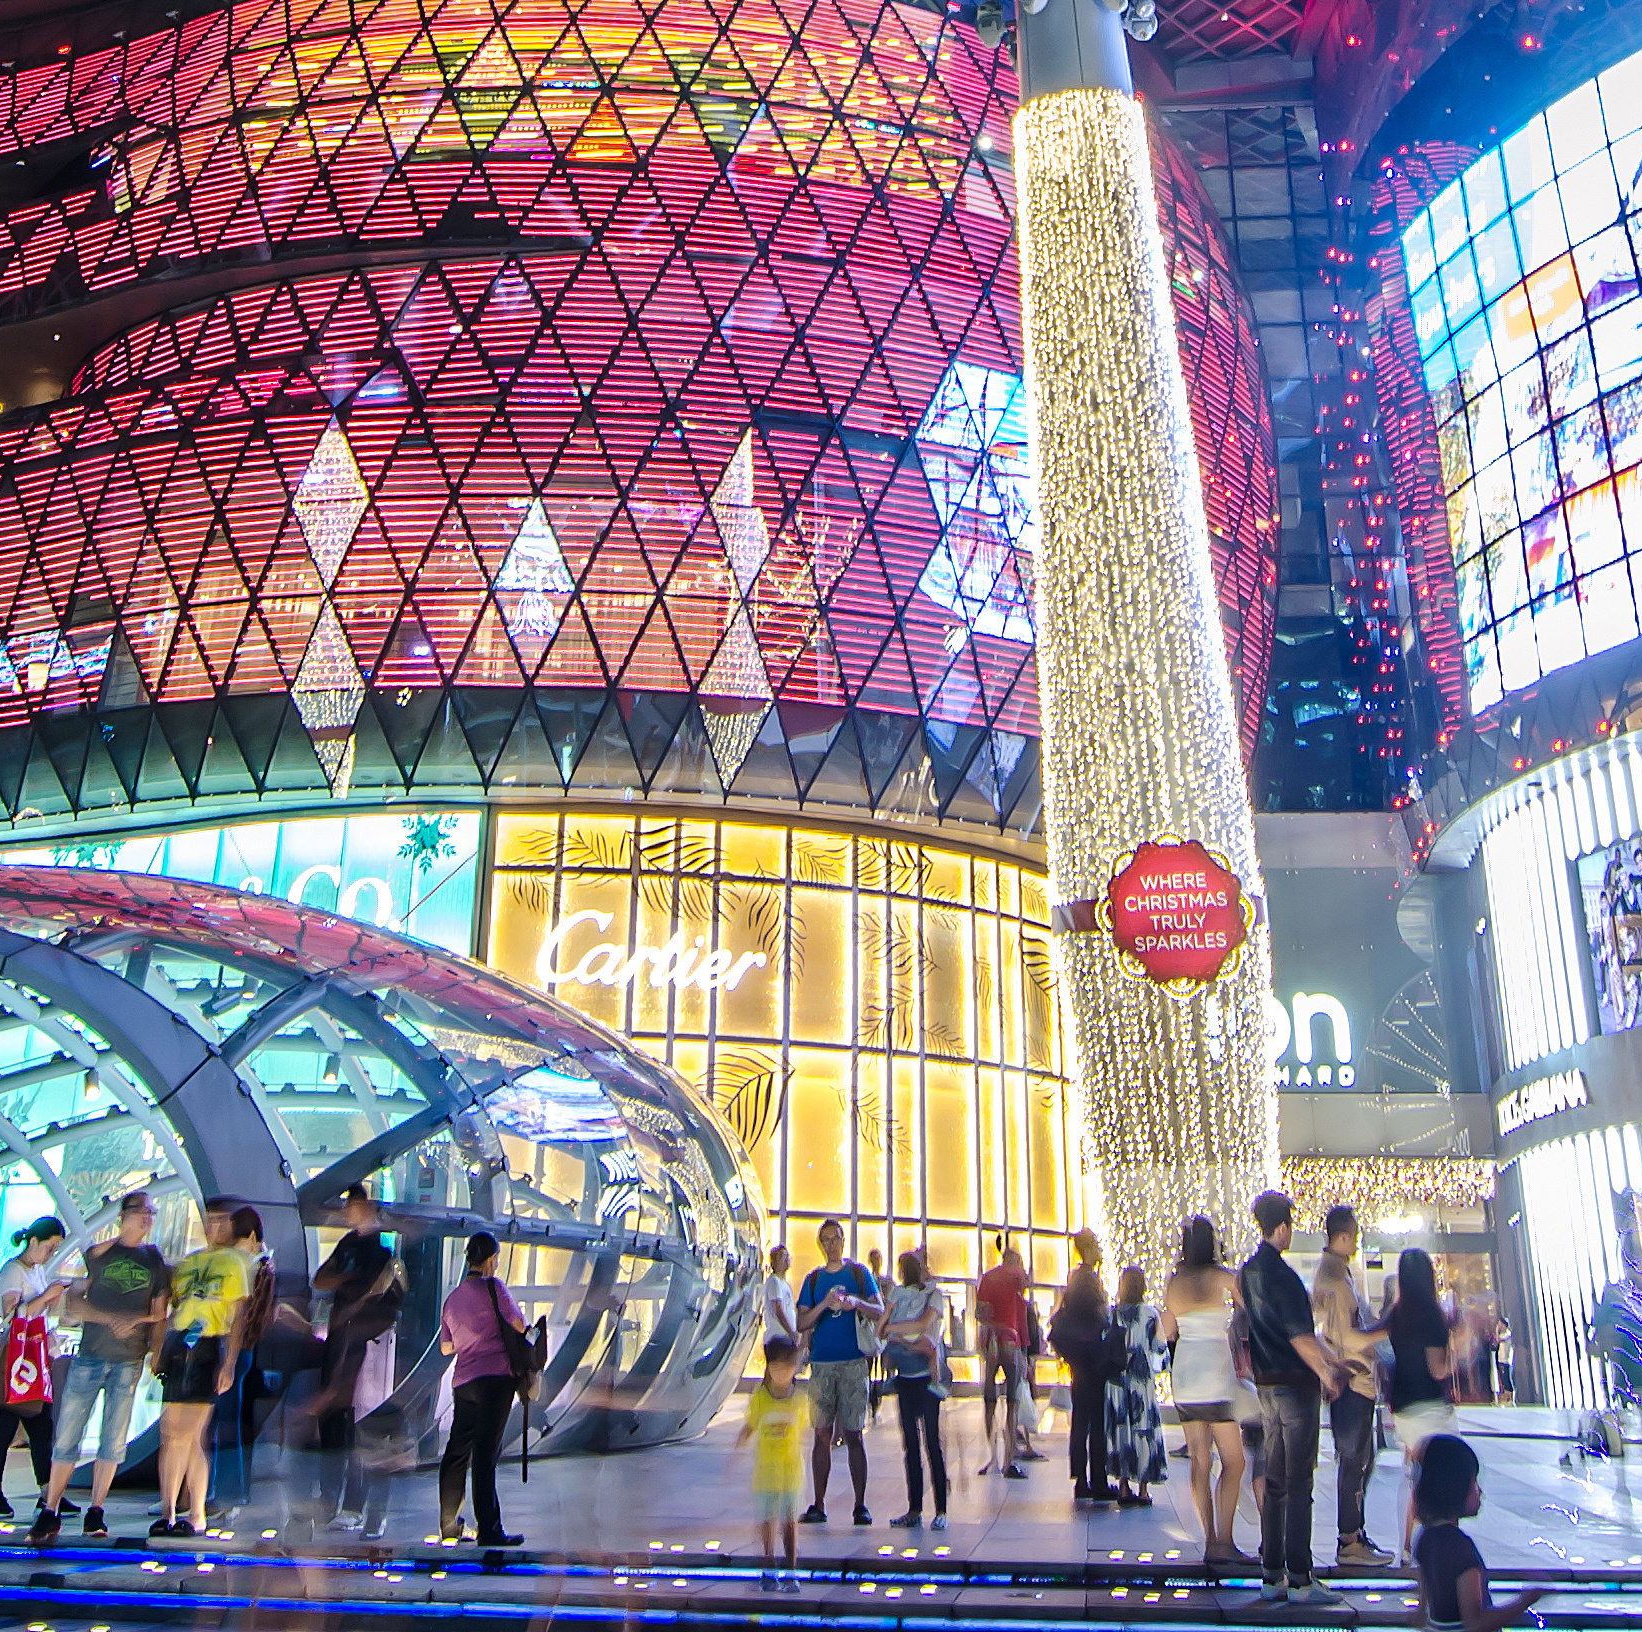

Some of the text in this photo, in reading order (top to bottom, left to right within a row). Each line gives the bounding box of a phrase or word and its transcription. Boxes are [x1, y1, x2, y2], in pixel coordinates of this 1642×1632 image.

[1140, 872, 1207, 891] WHERE
[1124, 891, 1228, 912] CHRISTMAS
[1149, 912, 1206, 931] TRULY
[536, 909, 767, 992] Cartier
[1134, 932, 1228, 952] SPARKLES
